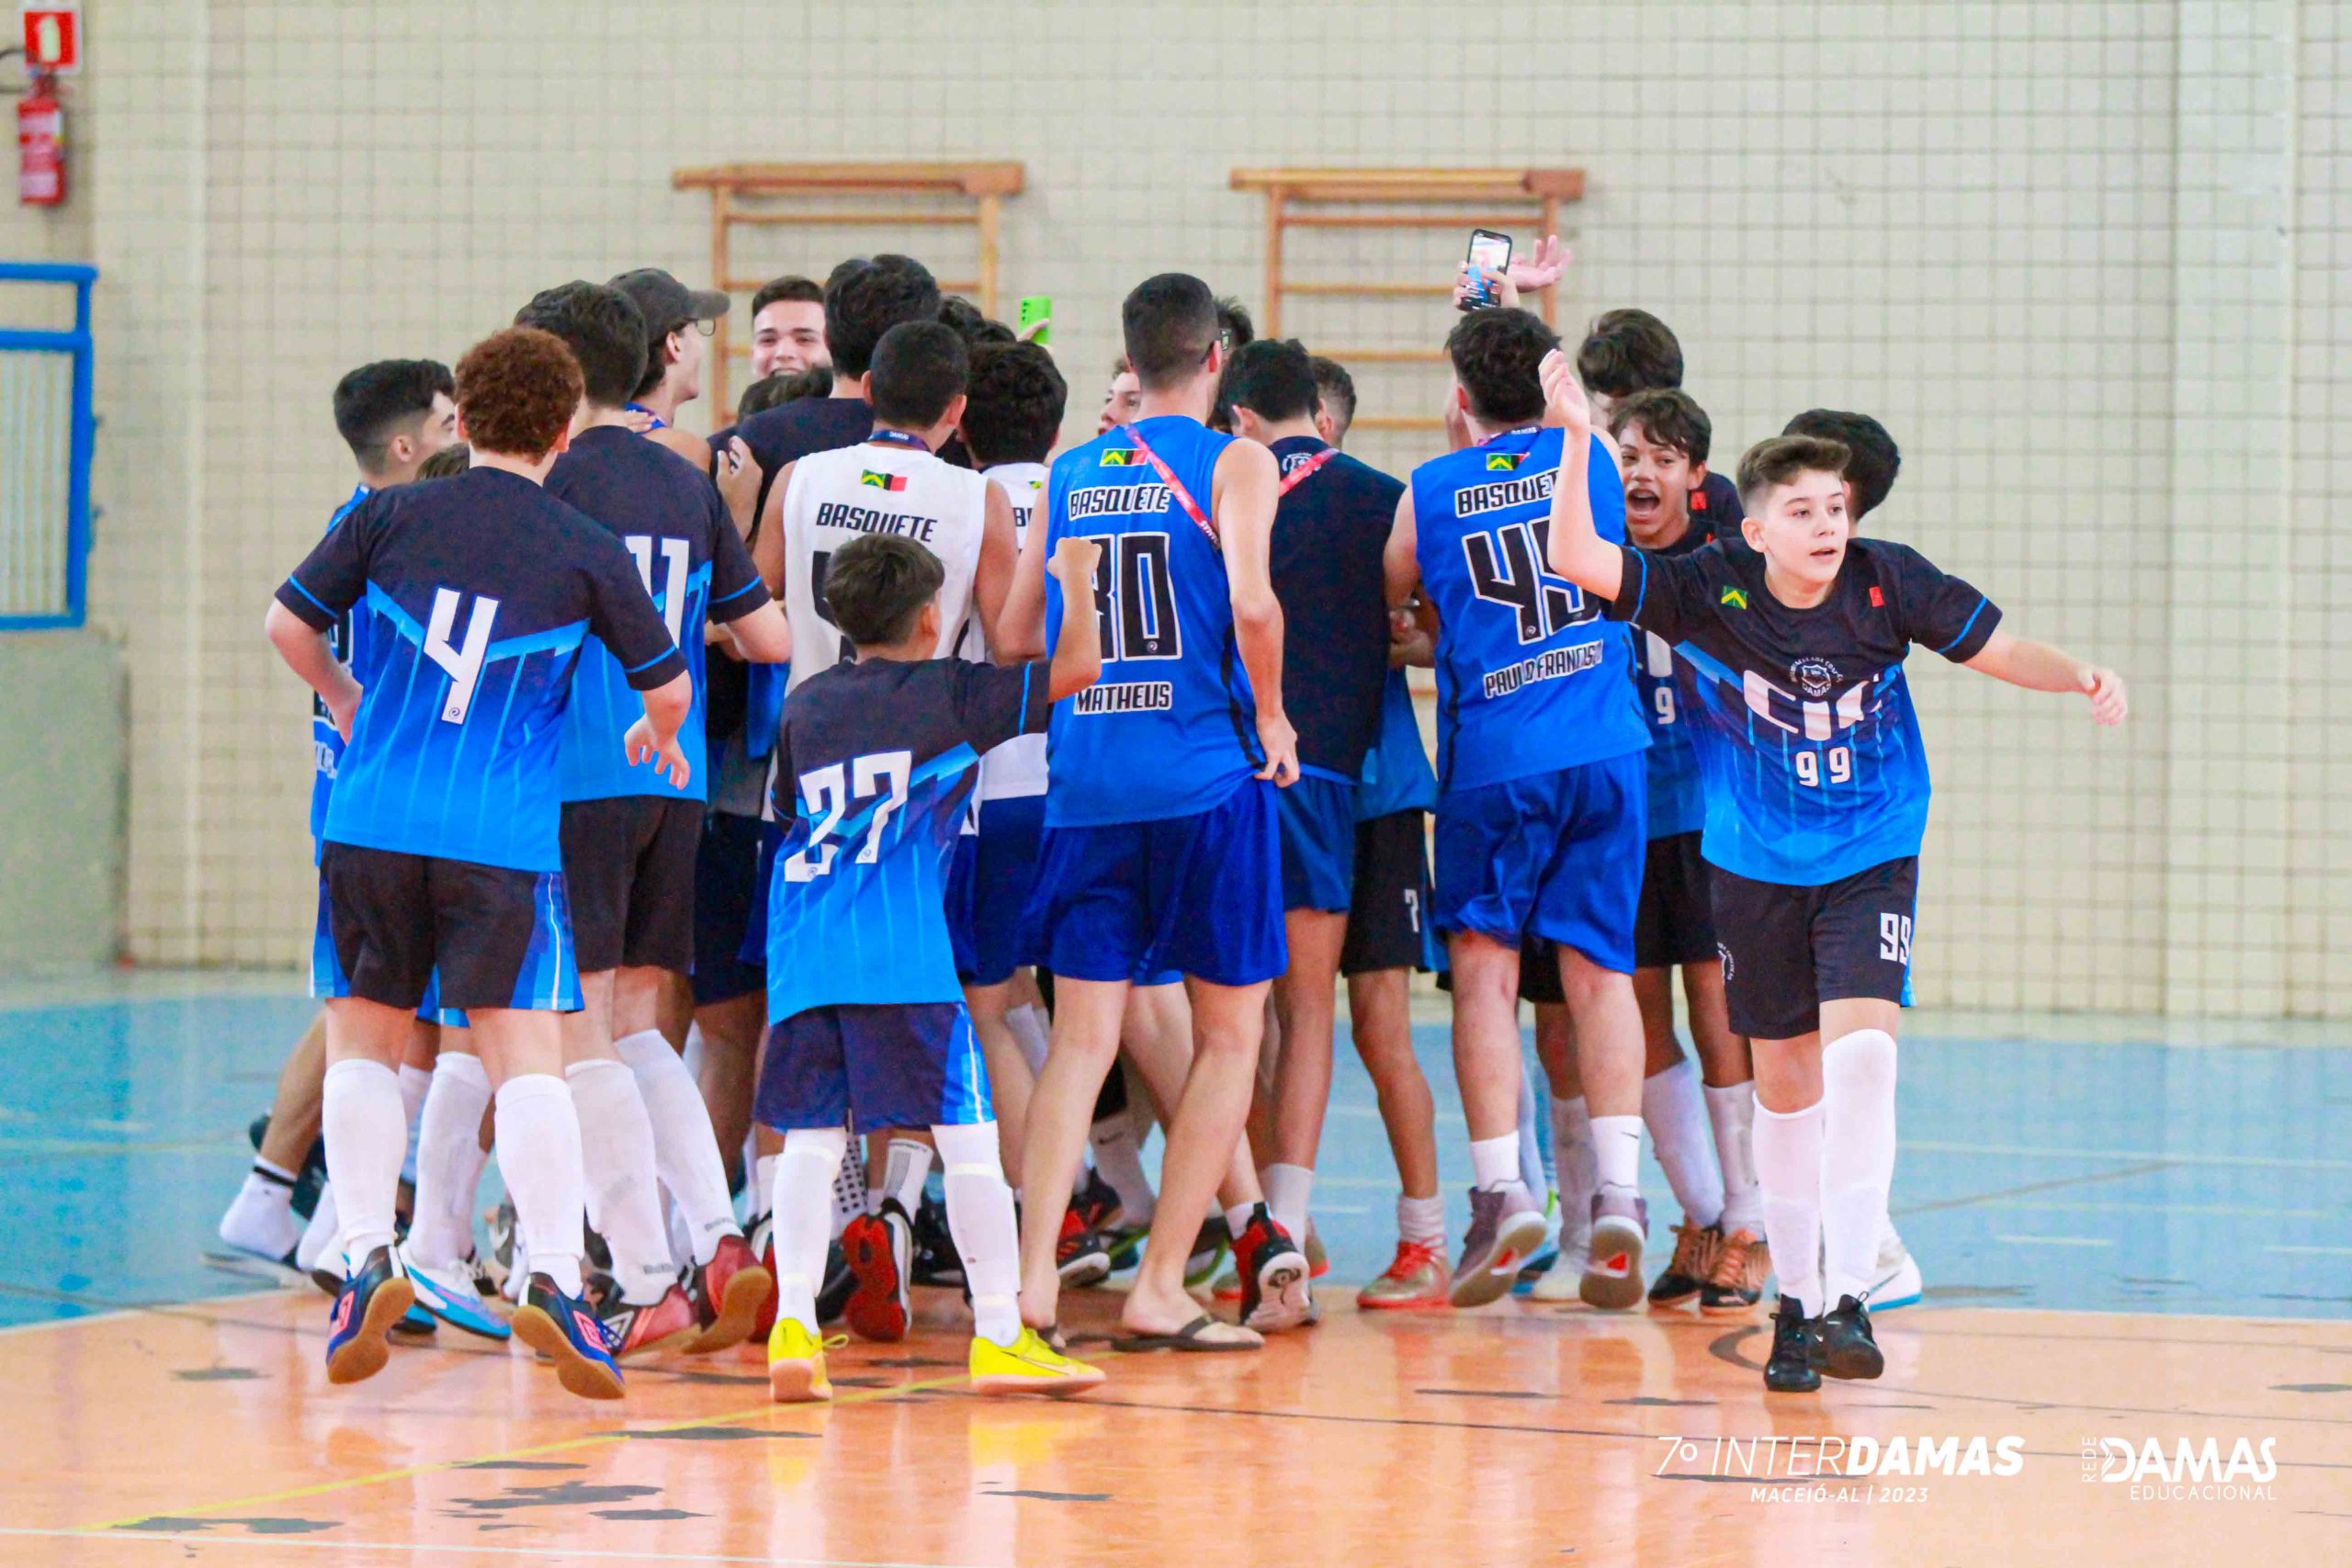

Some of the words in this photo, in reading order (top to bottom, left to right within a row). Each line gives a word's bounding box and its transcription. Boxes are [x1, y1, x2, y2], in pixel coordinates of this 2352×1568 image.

[1070, 485, 1170, 519] BASQUETE
[1456, 468, 1558, 517] BASQUET
[816, 502, 938, 543] BASQUETE
[1462, 515, 1601, 644] 45
[423, 587, 499, 725] 4
[1075, 682, 1171, 714] MATHEUS
[1656, 686, 1676, 725] 9
[1795, 746, 1851, 788] 99
[785, 750, 912, 883] 27
[1404, 888, 1419, 933] 7
[1880, 912, 1912, 965] 99
